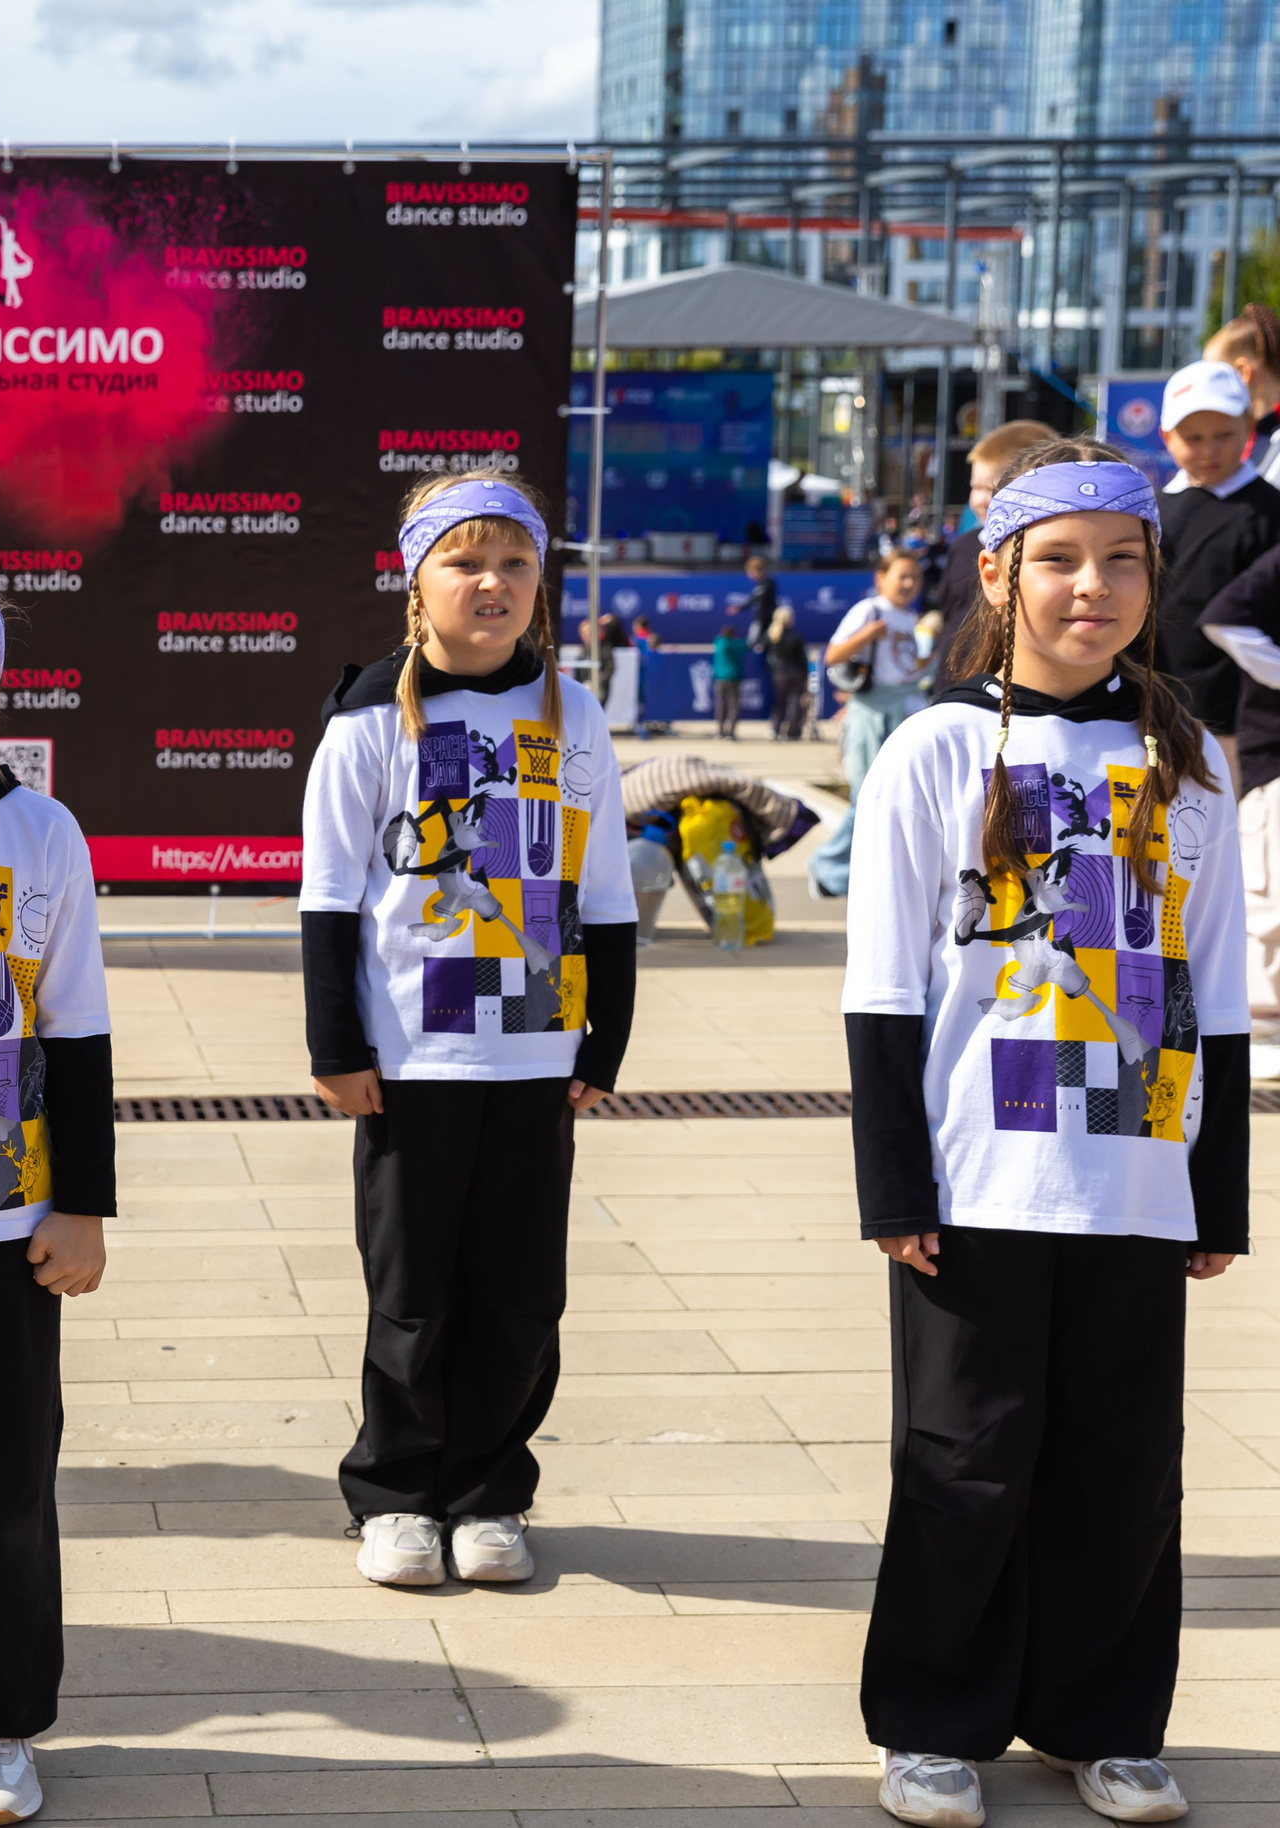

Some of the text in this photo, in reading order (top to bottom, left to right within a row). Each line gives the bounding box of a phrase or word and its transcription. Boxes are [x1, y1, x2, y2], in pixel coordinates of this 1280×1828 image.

[385, 182, 530, 204] BRAVISSIMO
[386, 202, 528, 226] dance studio
[165, 245, 308, 268] BRAVISSIMO
[237, 266, 307, 290] studio
[382, 306, 525, 329] BRAVISSIMO
[382, 326, 524, 350] dance studio
[66, 371, 158, 396] студия
[234, 389, 303, 413] studio
[379, 429, 521, 451] BRAVISSIMO
[379, 449, 520, 473] dance studio
[159, 492, 301, 513] BRAVISSIMO
[160, 511, 300, 534] dance studio
[13, 570, 82, 592] studio
[157, 612, 298, 632] BRAVISSIMO
[158, 630, 297, 653] dance studio
[12, 688, 81, 710] studio
[155, 729, 295, 749] BRAVISSIMO
[421, 735, 467, 762] SPACE
[156, 747, 294, 769] dance studio
[426, 761, 463, 787] JAM
[521, 774, 558, 787] DUNK
